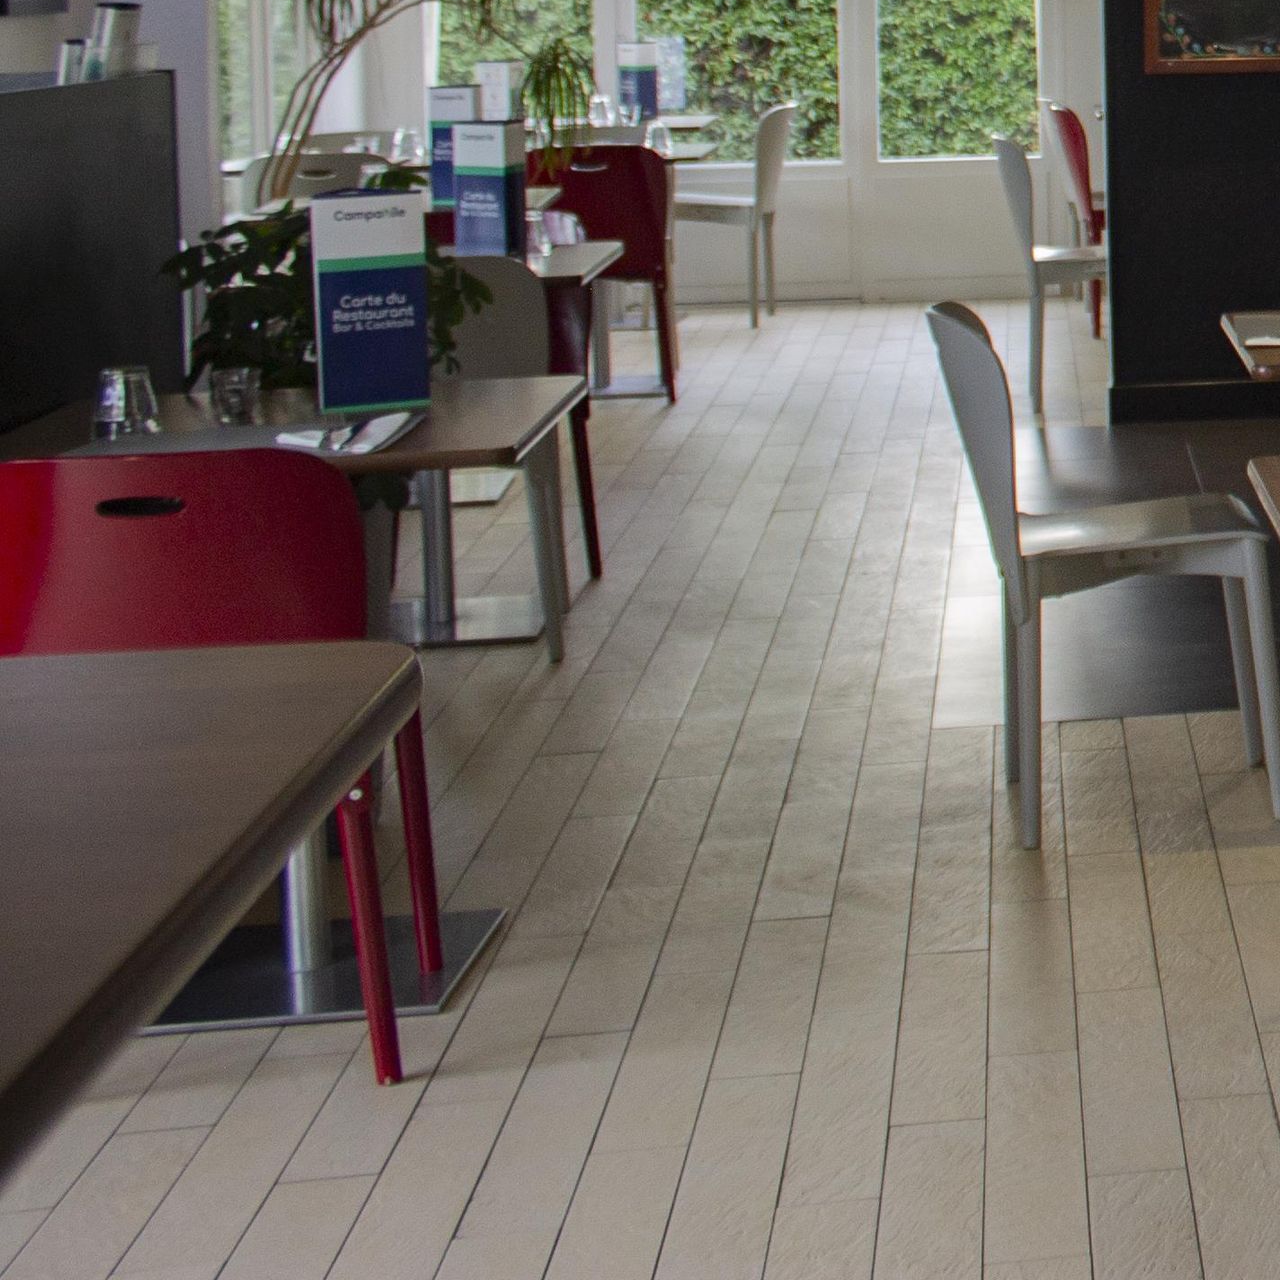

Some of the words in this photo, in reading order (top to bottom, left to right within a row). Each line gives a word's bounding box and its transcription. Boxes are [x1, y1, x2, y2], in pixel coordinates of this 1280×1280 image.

[333, 206, 406, 222] Campanile
[340, 294, 383, 309] Carte
[386, 292, 407, 306] du
[332, 305, 415, 323] Restaurant
